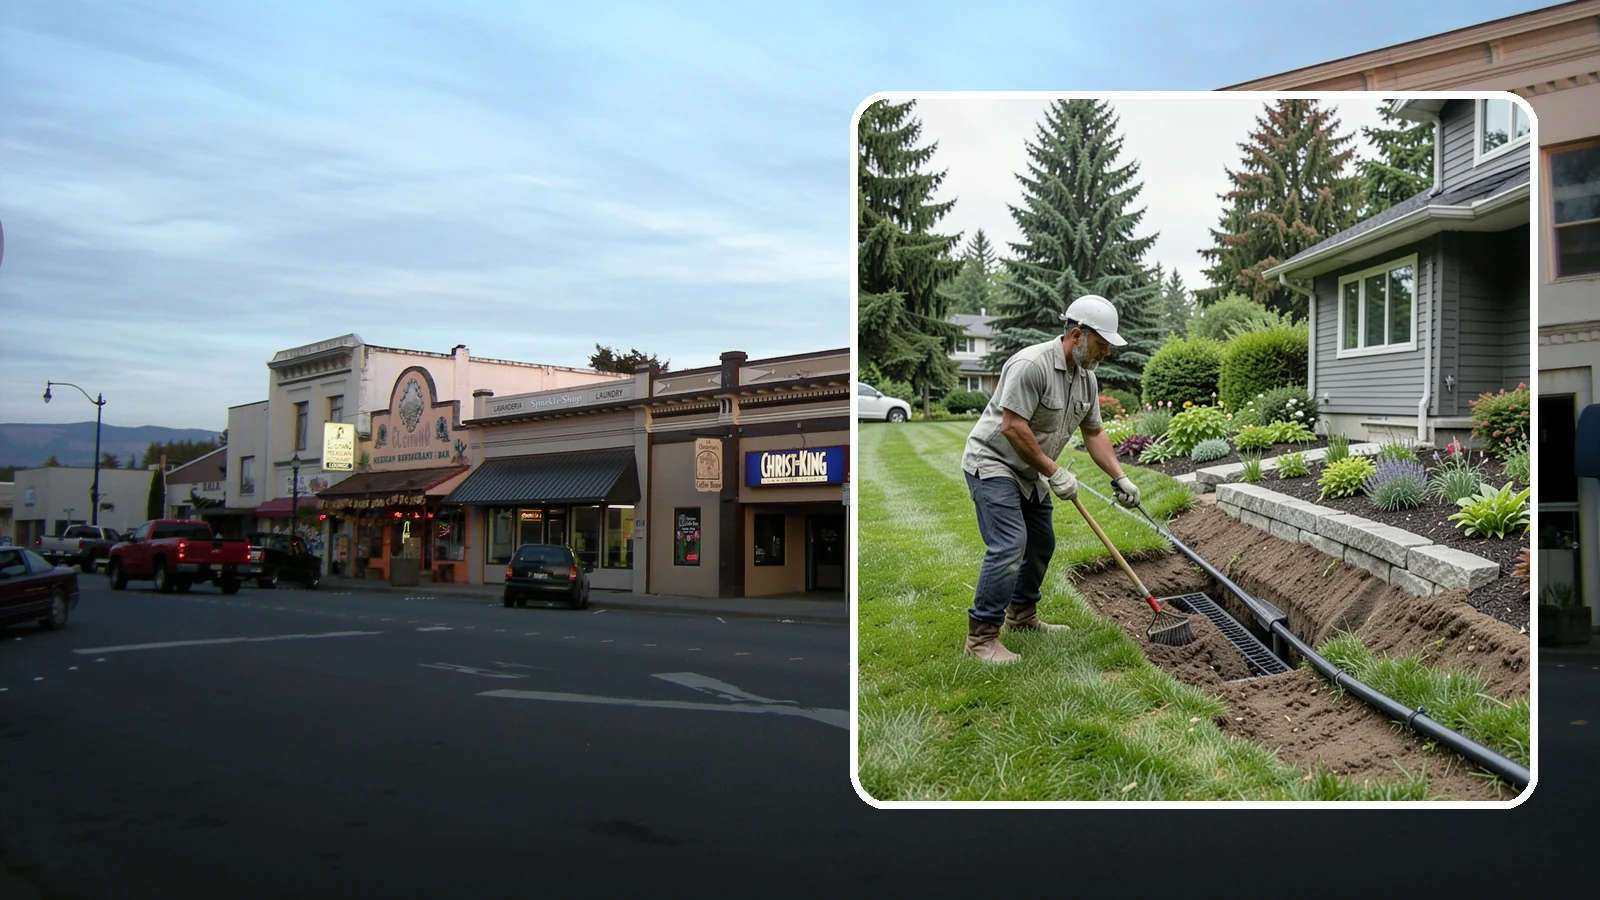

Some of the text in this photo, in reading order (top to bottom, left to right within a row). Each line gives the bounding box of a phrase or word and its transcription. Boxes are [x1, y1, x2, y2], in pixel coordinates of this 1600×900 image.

[595, 389, 623, 400] LAUNDRY
[493, 402, 522, 413] LAVANDERIA
[531, 394, 582, 409] Sparkle Shop
[397, 452, 433, 462] RESTAURANT
[437, 450, 450, 459] BAR
[761, 450, 827, 478] CHRIST KING
